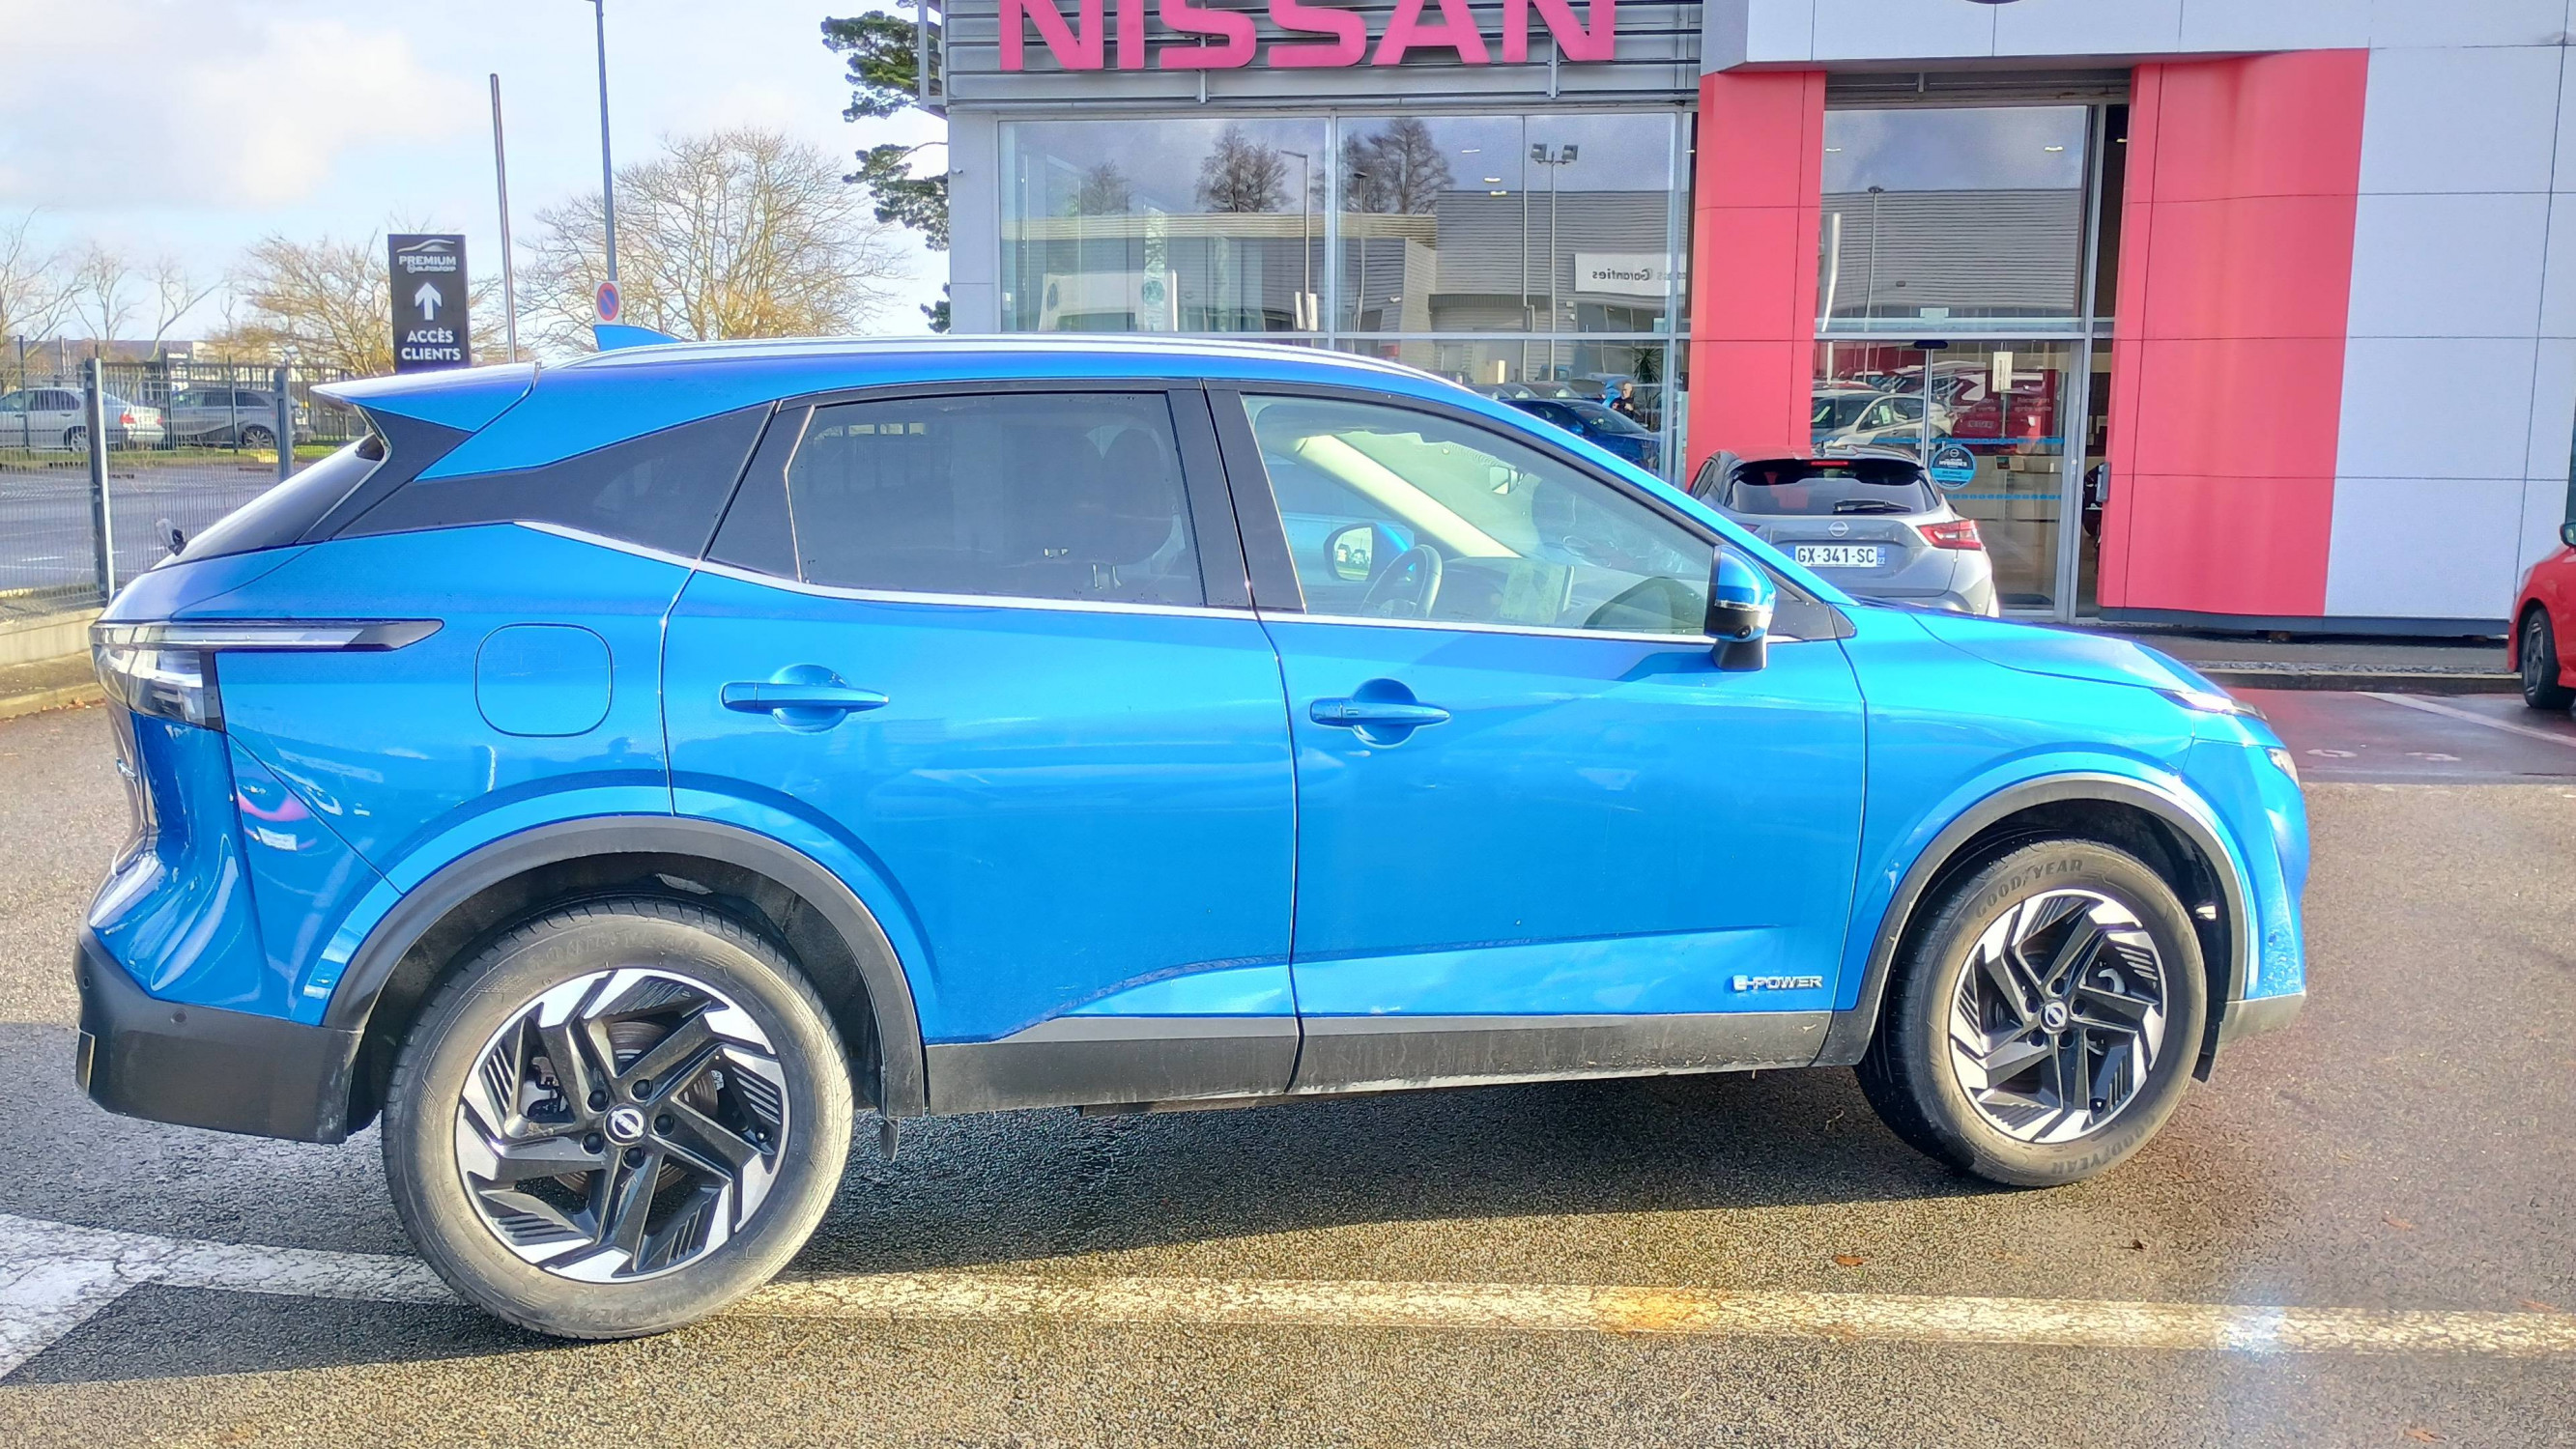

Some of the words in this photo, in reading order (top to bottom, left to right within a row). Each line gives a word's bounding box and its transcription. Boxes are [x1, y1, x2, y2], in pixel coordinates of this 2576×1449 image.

[999, 0, 1616, 71] NISSAN
[398, 255, 456, 266] PREMIUM
[407, 327, 454, 344] ACCÈS
[401, 348, 462, 361] CLIENTS
[1797, 548, 1875, 563] GX-341-SC
